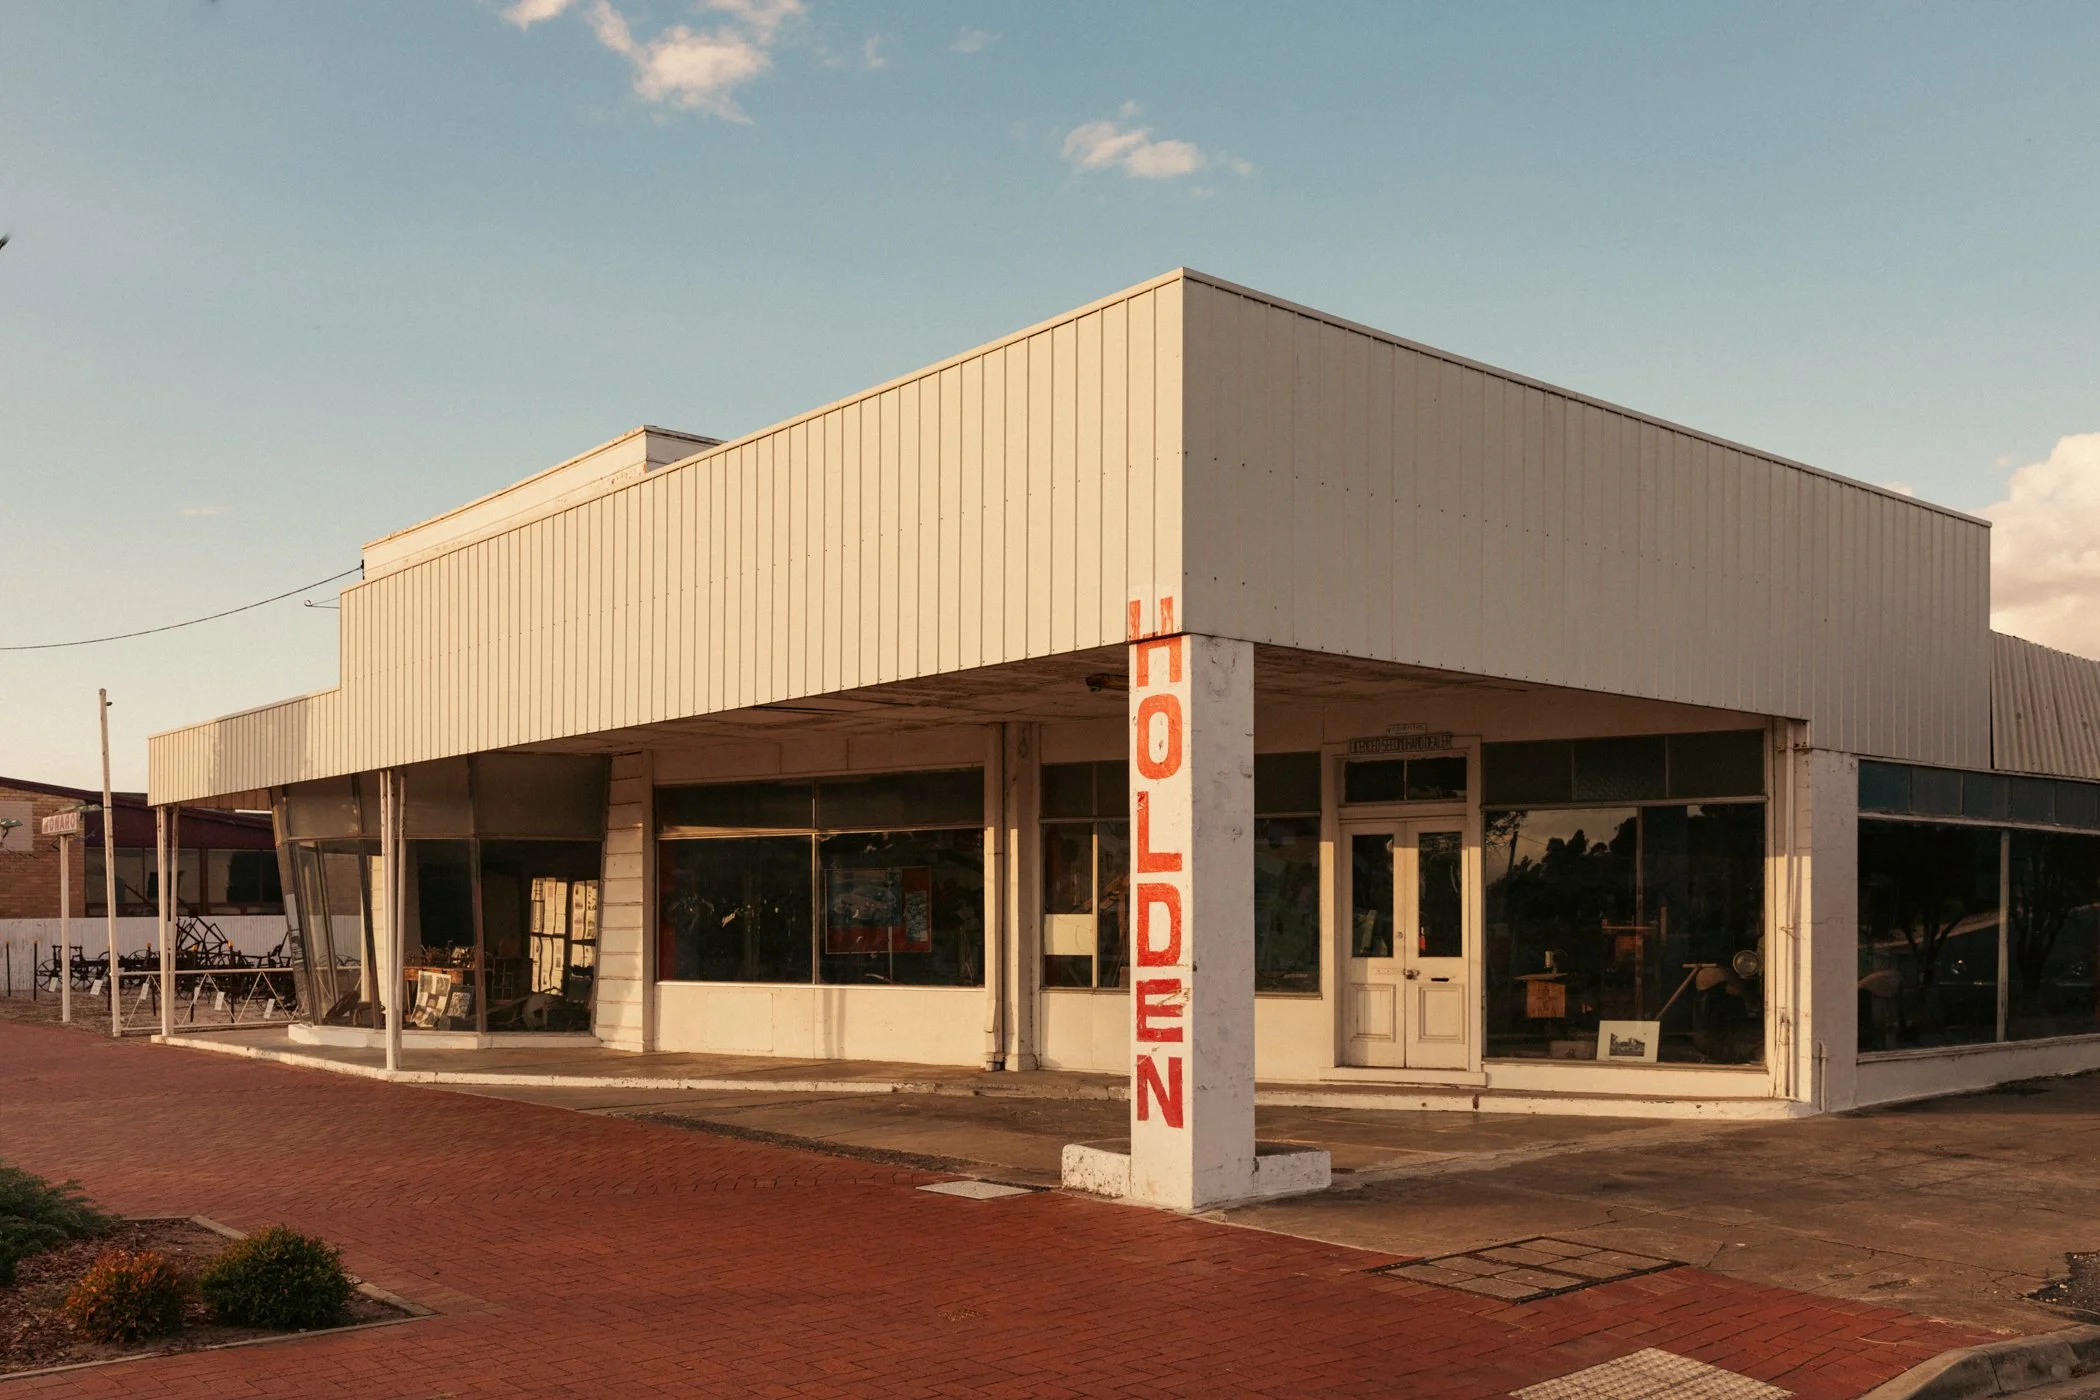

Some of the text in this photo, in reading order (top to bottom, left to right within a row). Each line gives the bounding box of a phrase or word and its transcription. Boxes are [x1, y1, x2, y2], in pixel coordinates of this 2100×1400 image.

[1424, 734, 1453, 750] DEALER
[43, 813, 76, 833] MONARO
[1129, 596, 1184, 1129] HOLDEN
